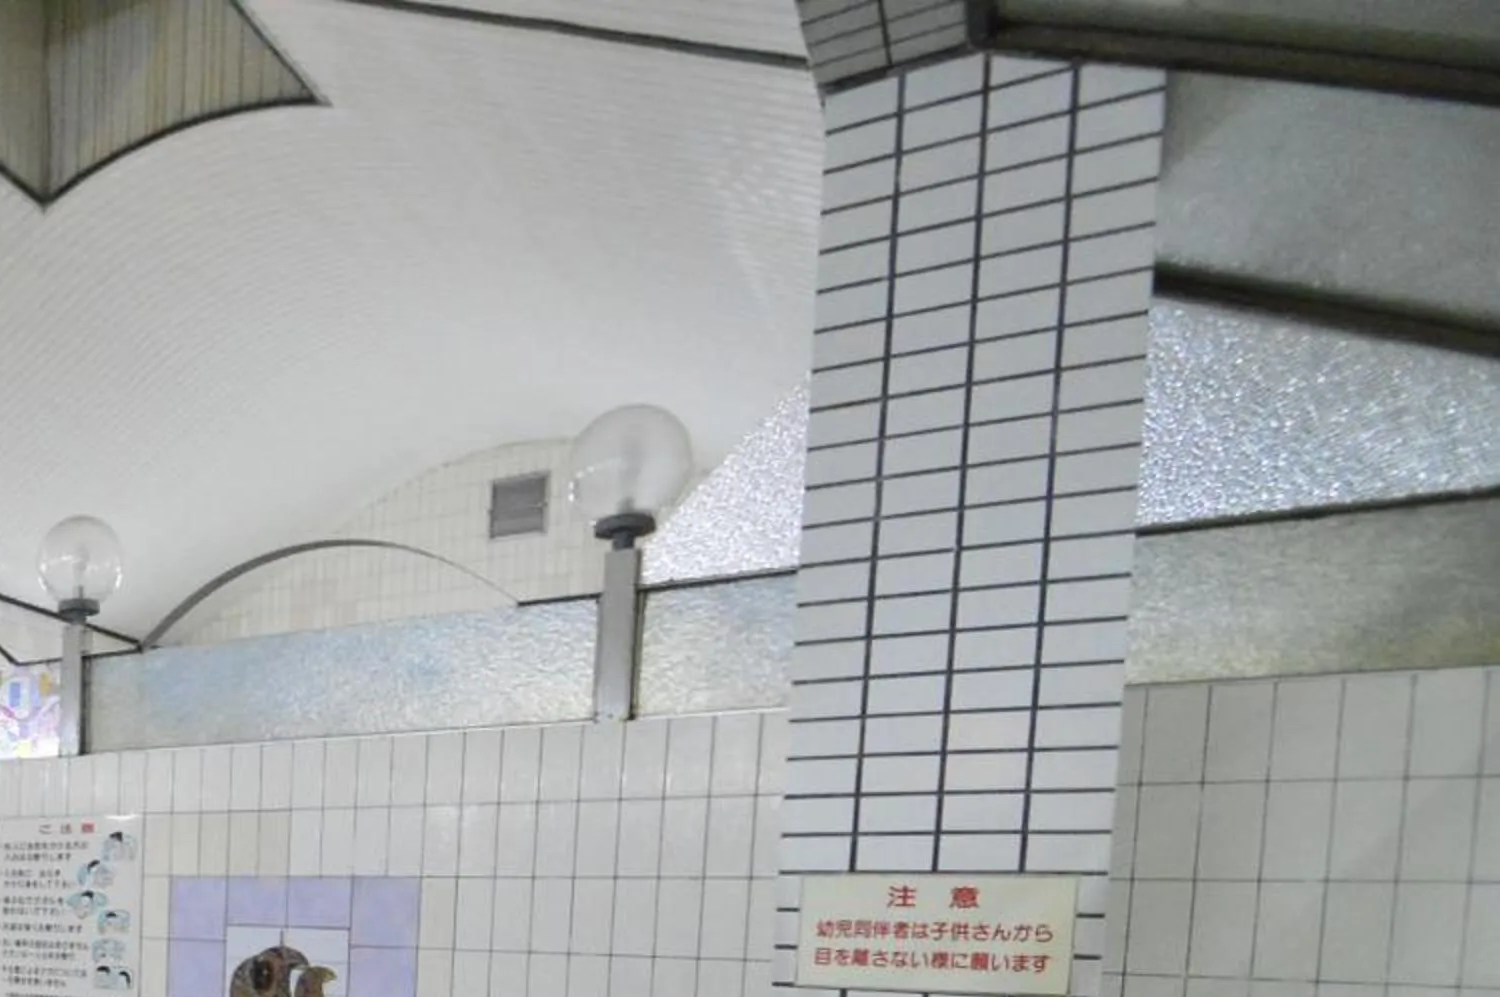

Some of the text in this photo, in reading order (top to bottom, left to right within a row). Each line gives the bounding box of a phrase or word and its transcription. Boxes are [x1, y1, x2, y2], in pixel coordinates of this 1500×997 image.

[887, 885, 981, 909] 注意
[815, 919, 1054, 943] 幼児同伴者は子供さんから
[813, 947, 1052, 973] 目を離さない様に願います
